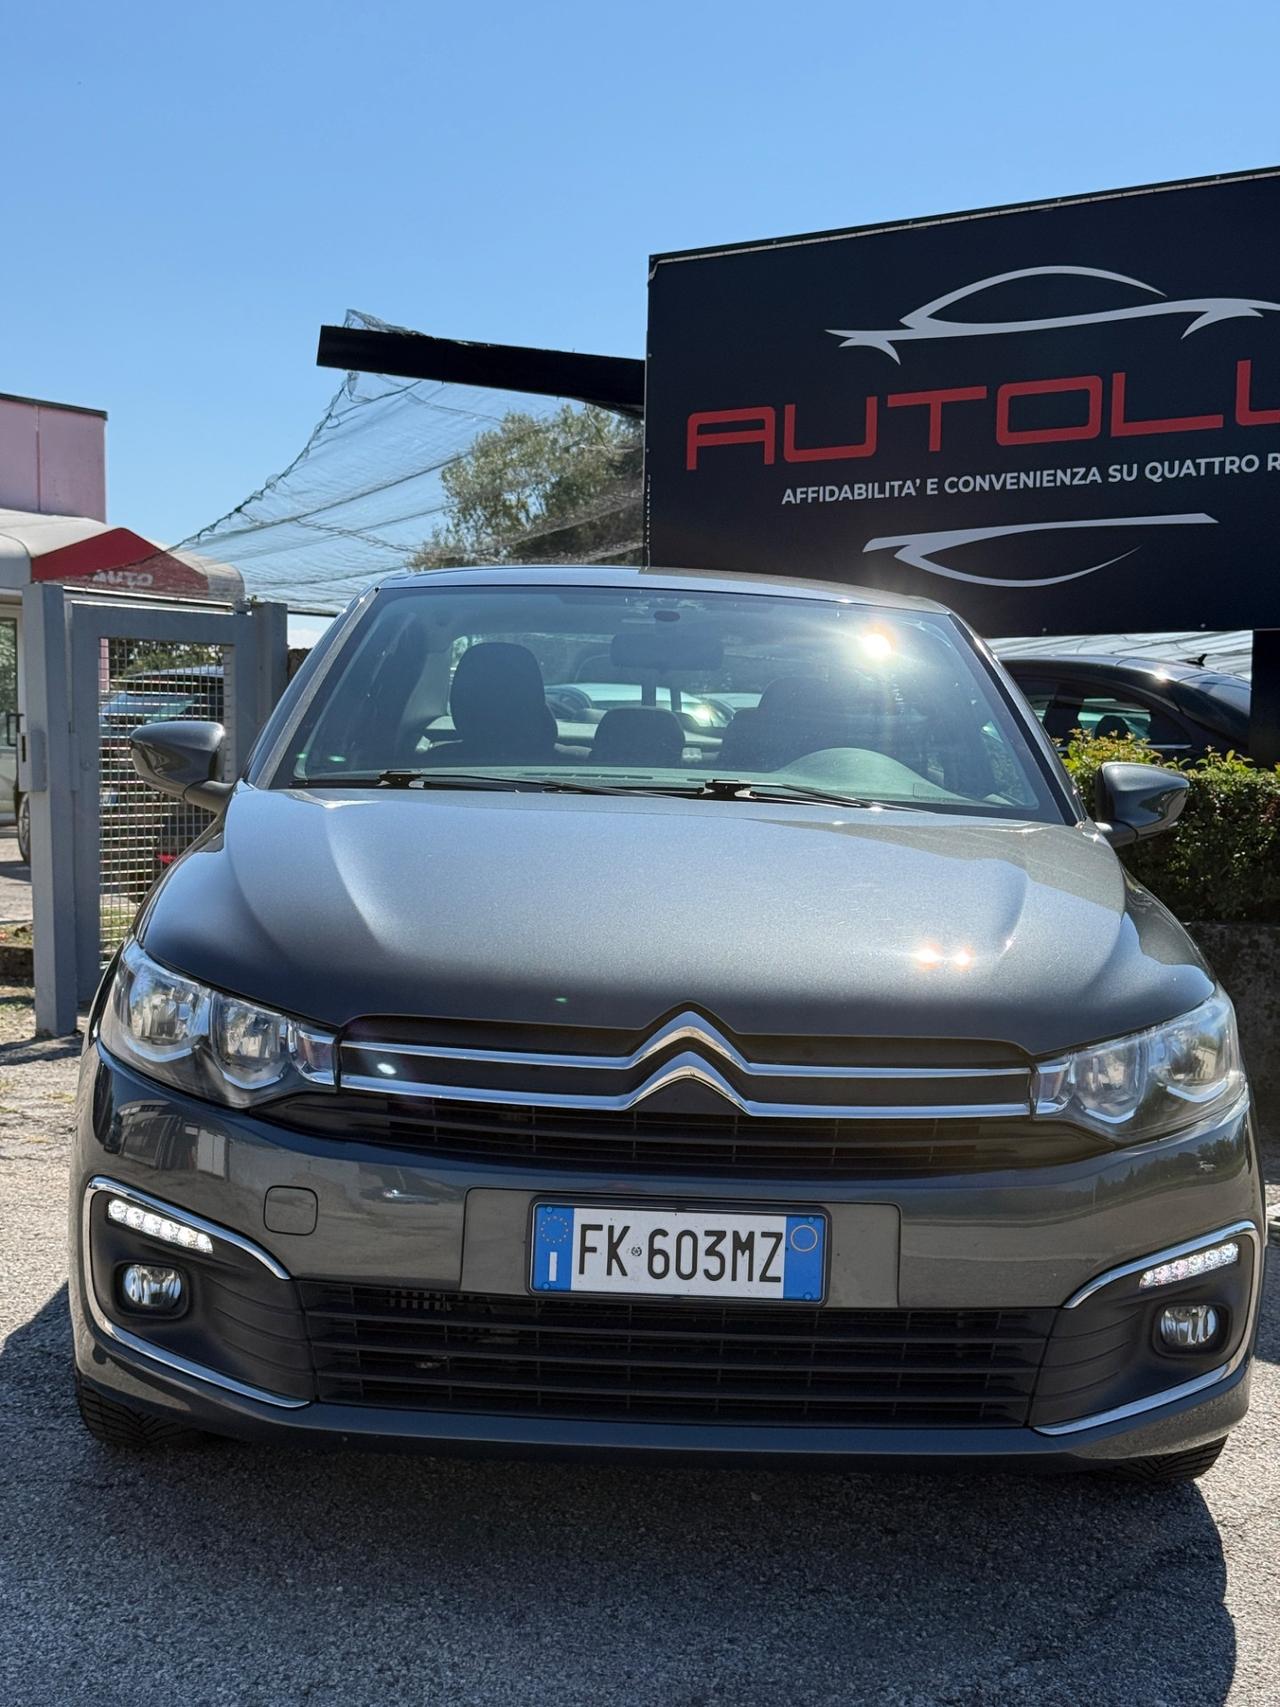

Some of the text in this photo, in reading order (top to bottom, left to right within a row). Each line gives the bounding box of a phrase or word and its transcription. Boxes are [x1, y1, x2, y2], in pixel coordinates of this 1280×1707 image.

[926, 478, 938, 495] E
[944, 466, 1102, 494] CONVENIENZA
[1108, 463, 1138, 482] SU
[1144, 454, 1260, 483] QUATTRO
